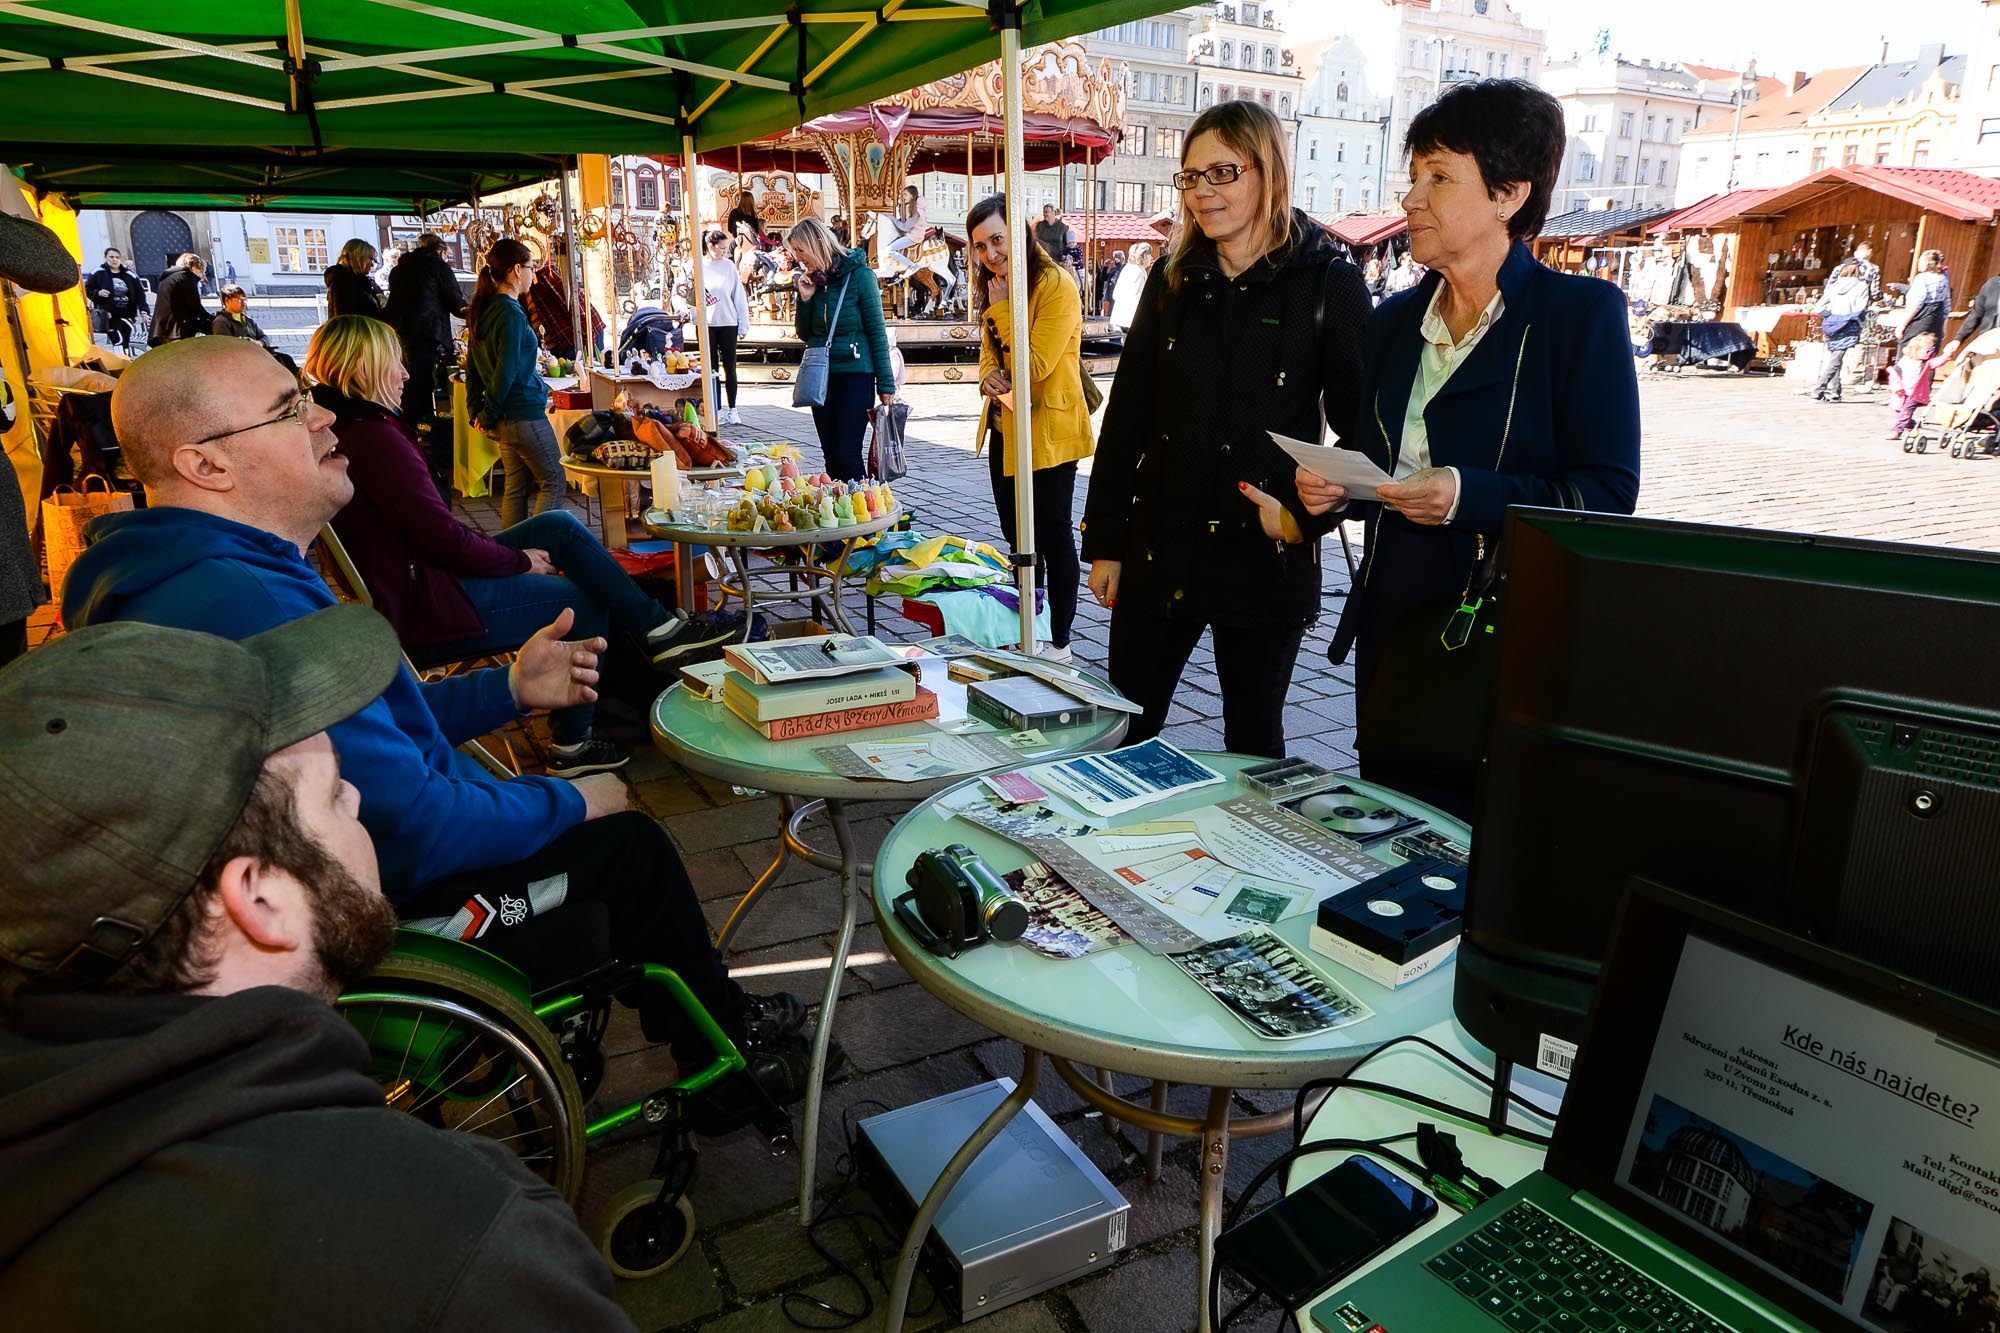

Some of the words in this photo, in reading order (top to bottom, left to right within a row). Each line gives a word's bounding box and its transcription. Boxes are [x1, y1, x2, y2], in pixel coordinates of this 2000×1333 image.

[826, 697, 845, 705] JOSEF
[846, 694, 863, 702] LADA
[869, 689, 888, 699] MIKEŠ
[780, 713, 841, 738] Pohádky
[843, 708, 883, 726] Boženy
[1331, 937, 1348, 949] SONY
[1403, 960, 1430, 979] SONY
[1682, 1032, 1728, 1058] Sdružení
[1729, 1055, 1767, 1078] občanů
[1769, 1072, 1809, 1097] Exodus
[1738, 1046, 1779, 1070] Adresa:
[1724, 1063, 1733, 1072] U
[1733, 1068, 1767, 1090] Zvonu
[1768, 1087, 1781, 1096] 51
[1783, 1024, 1823, 1055] Kde
[1829, 1051, 1867, 1075] nás
[1874, 1067, 1980, 1123] najdete?
[1704, 1068, 1723, 1082] 330
[1741, 1084, 1794, 1116] Třemošná
[1902, 1160, 1935, 1183] Mail:
[1922, 1154, 1946, 1174] Tel:
[1950, 1169, 1970, 1186] 773
[1974, 1181, 1999, 1197] 656
